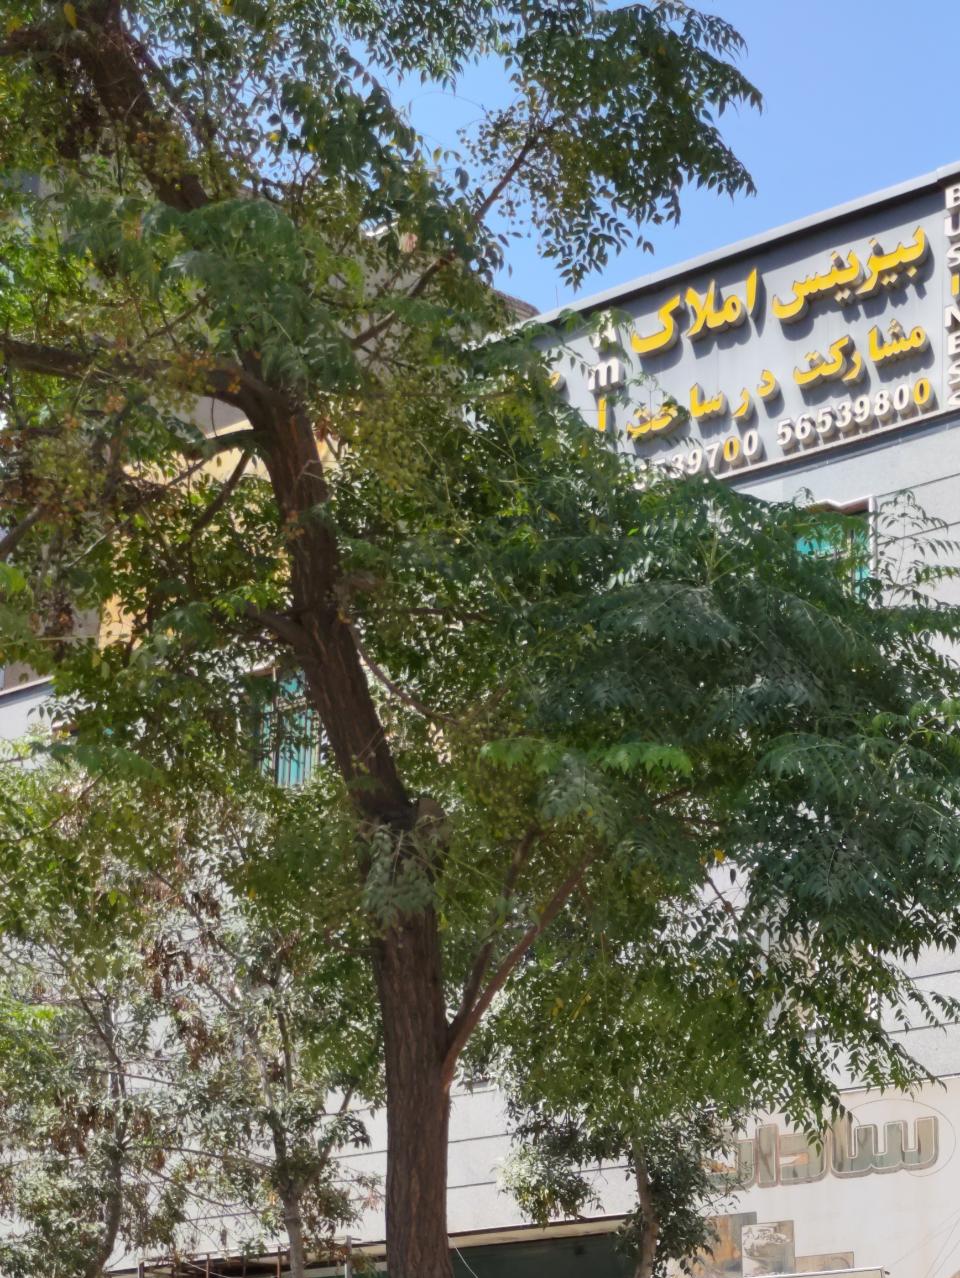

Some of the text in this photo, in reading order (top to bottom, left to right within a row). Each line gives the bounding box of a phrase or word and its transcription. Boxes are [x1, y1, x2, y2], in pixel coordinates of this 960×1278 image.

[630, 225, 926, 355] بیزینس املاک
[792, 318, 927, 386] مشارکت
[776, 377, 931, 448] 56539800
